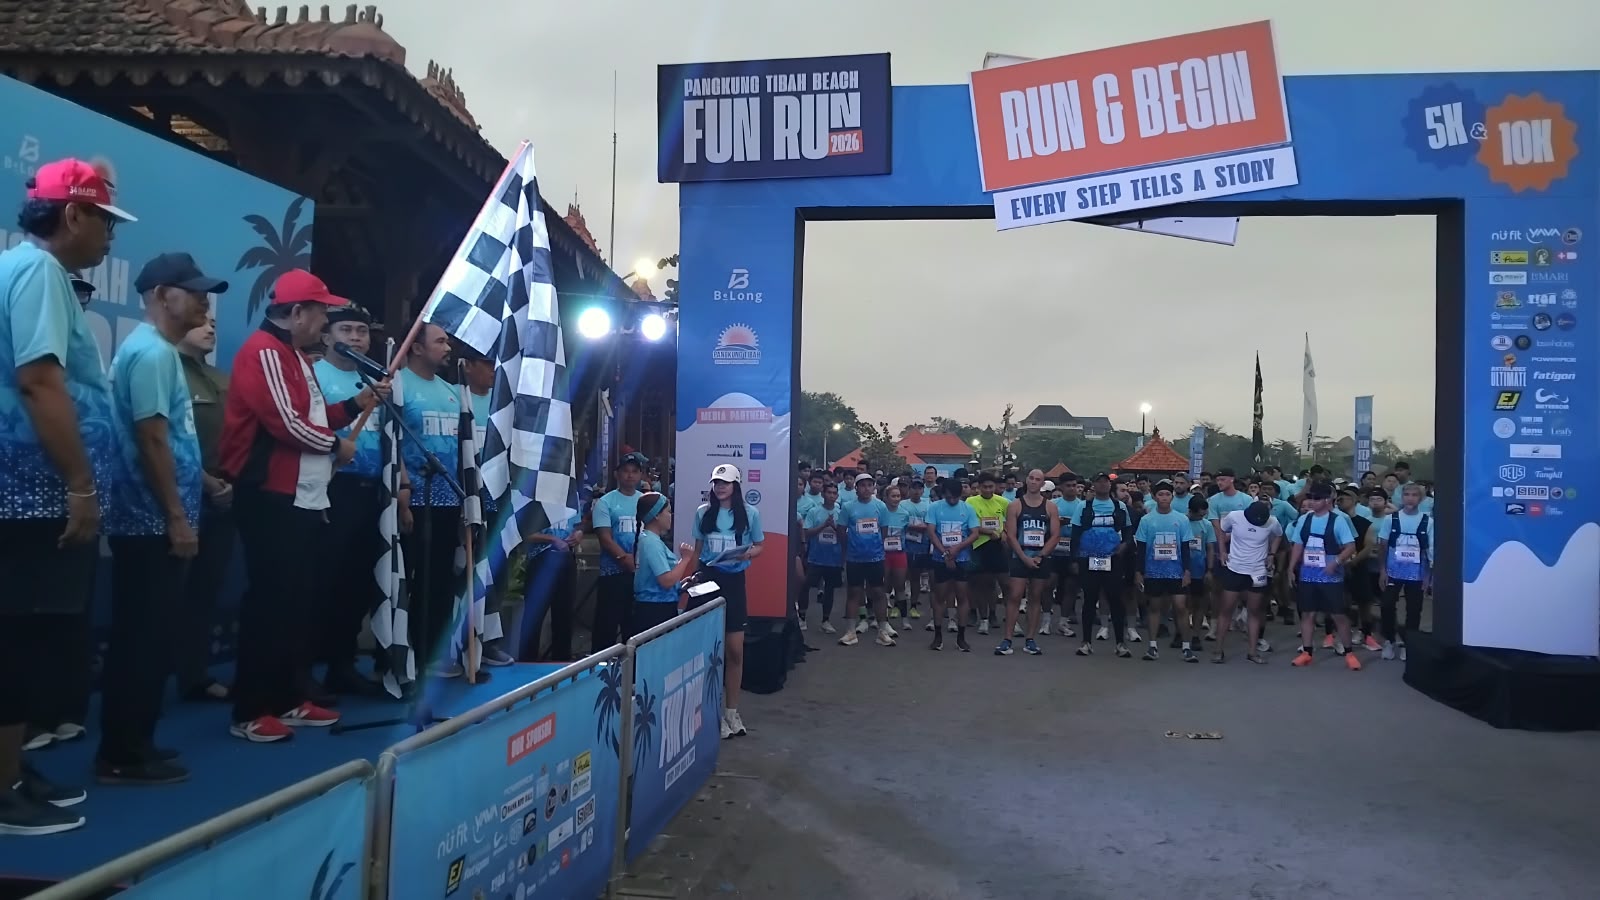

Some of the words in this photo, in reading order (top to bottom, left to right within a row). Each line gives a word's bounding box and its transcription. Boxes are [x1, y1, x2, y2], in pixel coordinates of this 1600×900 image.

[684, 75, 760, 97] PANGKUNG
[766, 73, 807, 93] TIBAH
[812, 70, 859, 91] BEACH
[1000, 80, 1086, 160] RUN
[1092, 73, 1126, 145] &
[1131, 50, 1256, 138] BEGIN
[683, 96, 761, 164] FUN
[773, 91, 861, 160] RUN
[831, 132, 860, 153] 2026
[1424, 101, 1469, 150] 5K
[1470, 122, 1488, 140] &
[1498, 118, 1556, 166] 10K
[1010, 190, 1067, 220] EVERY
[1077, 182, 1122, 210] STEP
[1130, 172, 1184, 201] TELLS
[1193, 169, 1206, 192] A
[1214, 157, 1275, 188] STORY
[1502, 466, 1523, 480] DEUS
[1022, 520, 1046, 530] BALI
